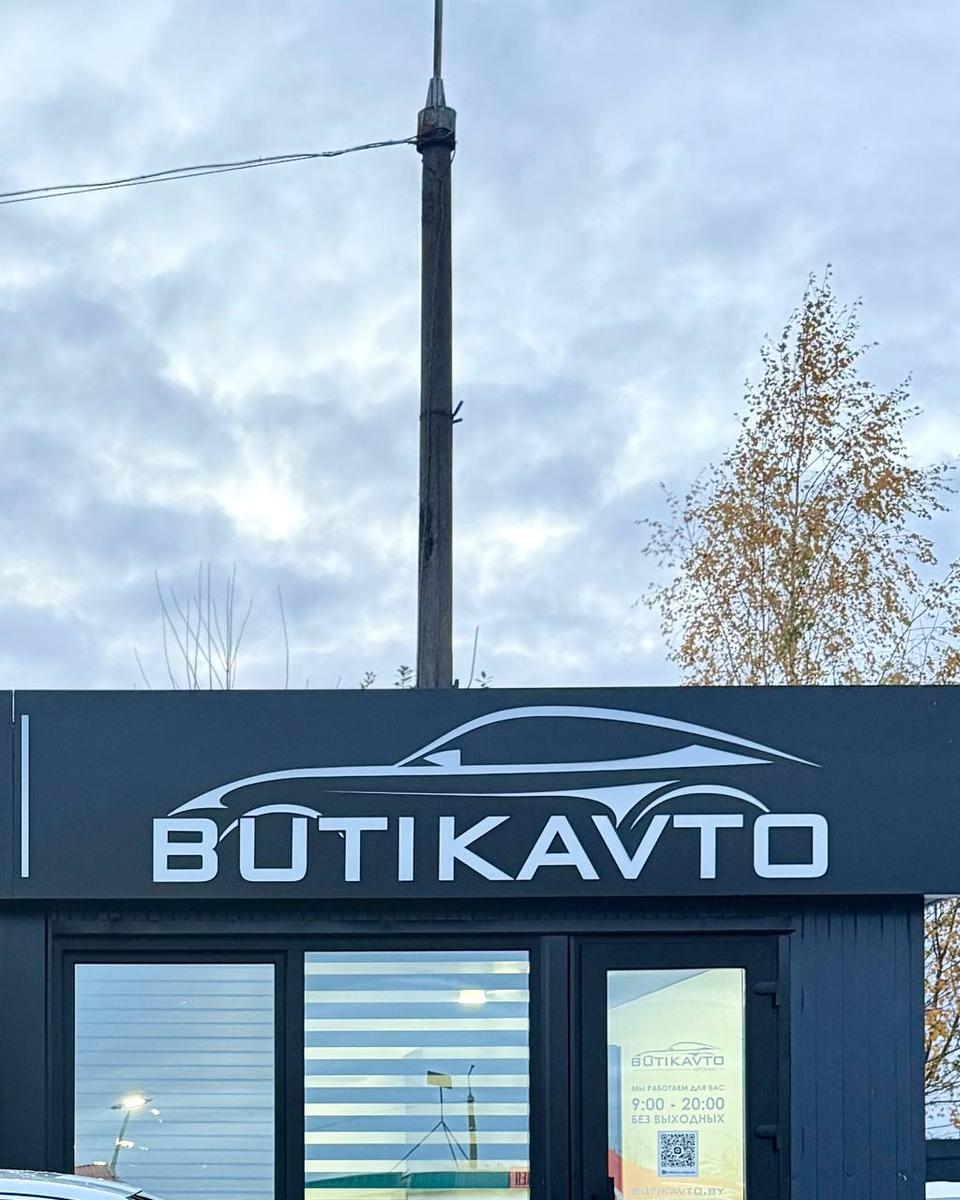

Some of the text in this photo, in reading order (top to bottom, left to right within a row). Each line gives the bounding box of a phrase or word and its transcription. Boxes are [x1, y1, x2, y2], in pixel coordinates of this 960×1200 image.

[152, 812, 829, 883] BUTIKAVTO
[632, 1055, 725, 1067] BUTIKAVTO
[632, 1097, 665, 1111] 9:00
[682, 1097, 725, 1111] 20:00
[632, 1114, 725, 1125] БЕЗ ВЫХОДНЫХ
